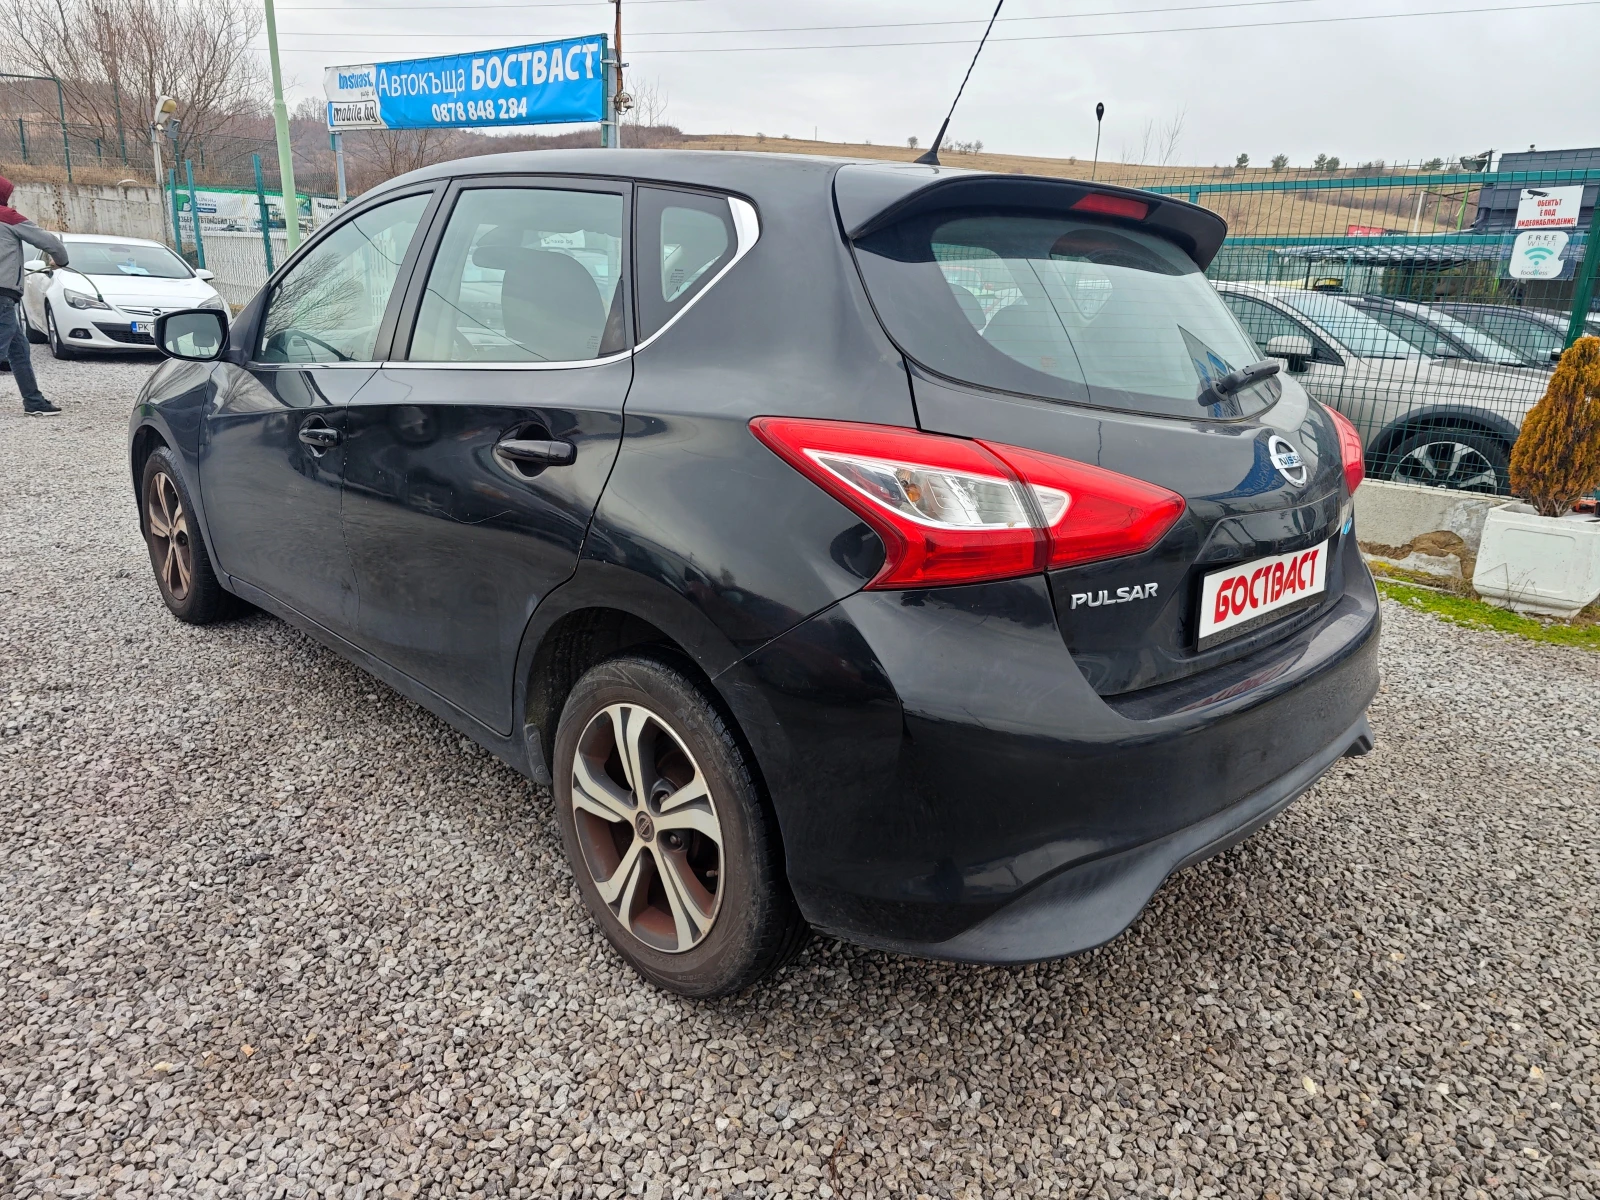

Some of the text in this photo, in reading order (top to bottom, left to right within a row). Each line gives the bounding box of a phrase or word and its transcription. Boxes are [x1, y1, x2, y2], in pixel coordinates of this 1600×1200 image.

[378, 43, 598, 98] Автокъща БОСТВАСТ
[333, 103, 378, 123] mobile.bg
[431, 97, 527, 122] 0878 848 284
[1070, 582, 1159, 610] PULSAR
[1213, 549, 1320, 624] БОСТВАСТ
